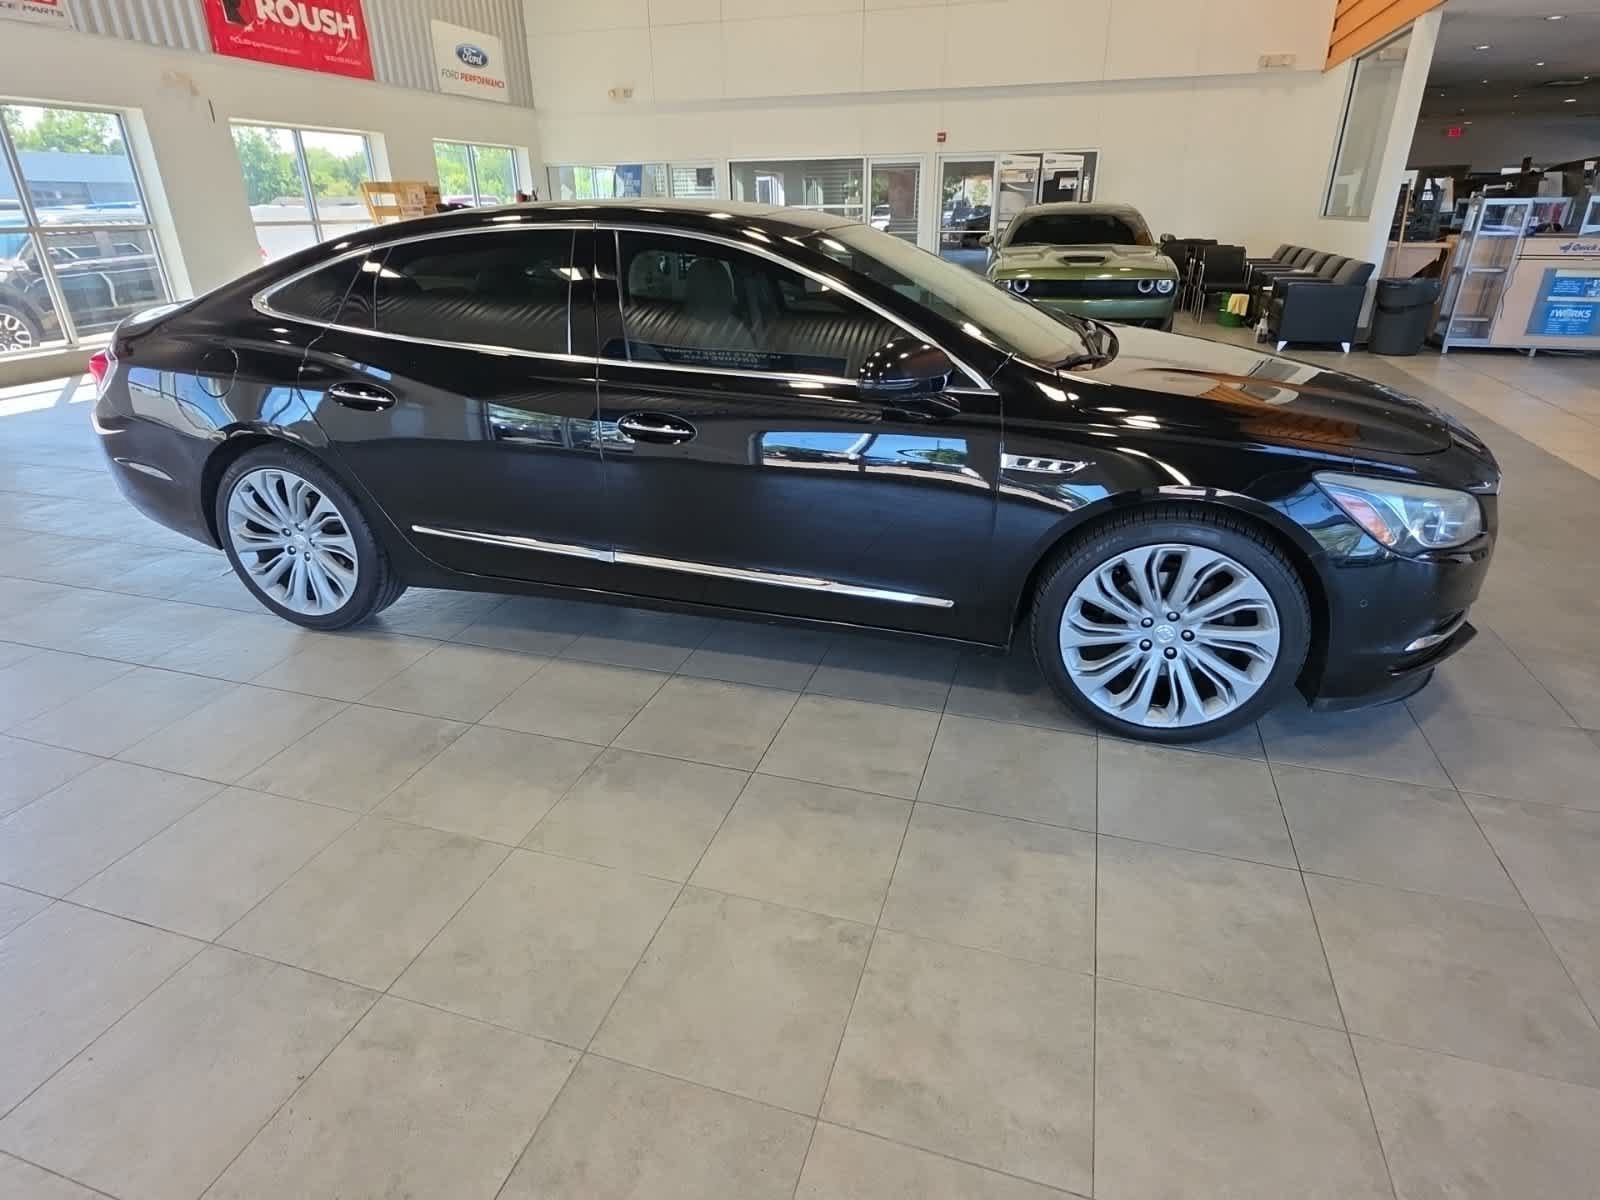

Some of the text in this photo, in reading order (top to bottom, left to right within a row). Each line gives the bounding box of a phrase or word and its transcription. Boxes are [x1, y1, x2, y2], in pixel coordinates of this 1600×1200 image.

[22, 5, 65, 18] PARTS
[255, 0, 358, 41] ROUSH
[462, 47, 483, 66] Ford
